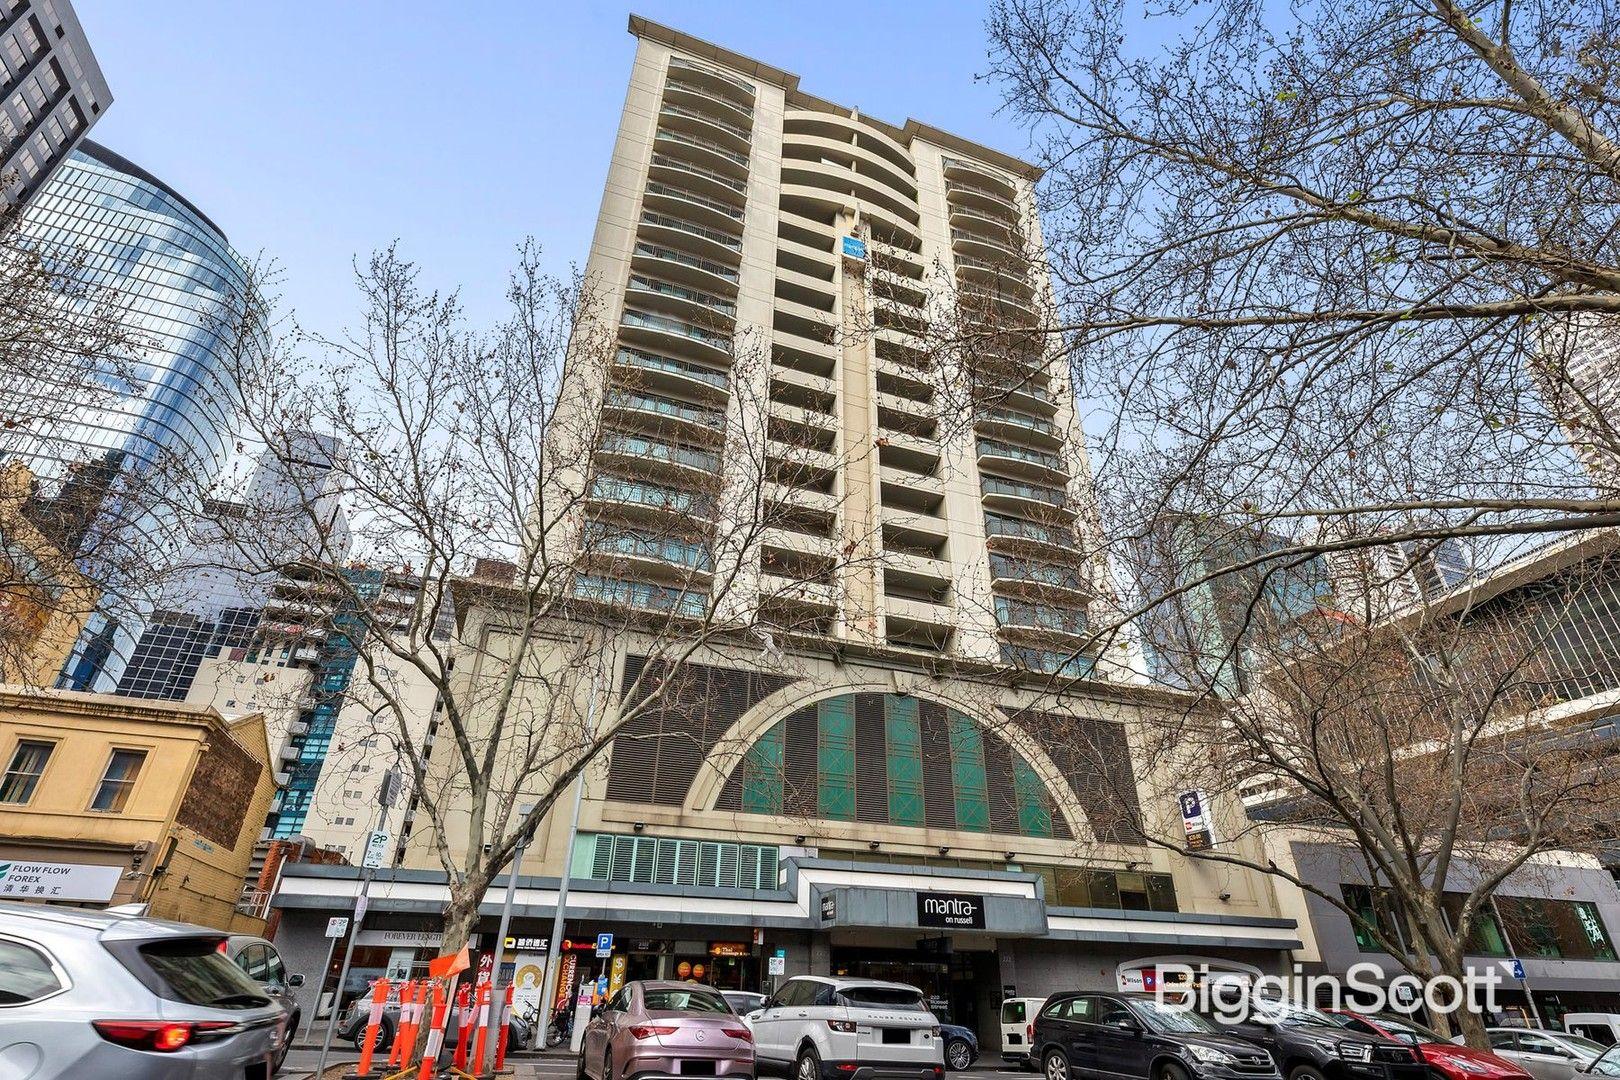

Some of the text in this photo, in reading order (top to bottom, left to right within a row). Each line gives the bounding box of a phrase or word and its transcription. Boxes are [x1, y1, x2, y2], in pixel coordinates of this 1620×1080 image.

[372, 834, 388, 844] 2P
[13, 865, 71, 875] FLOW FLOW
[8, 875, 41, 883] FOREX
[3, 884, 62, 895] 清华换汇
[925, 898, 977, 915] mantra
[384, 932, 416, 940] FOREVER
[601, 937, 609, 948] P
[615, 957, 623, 969] $
